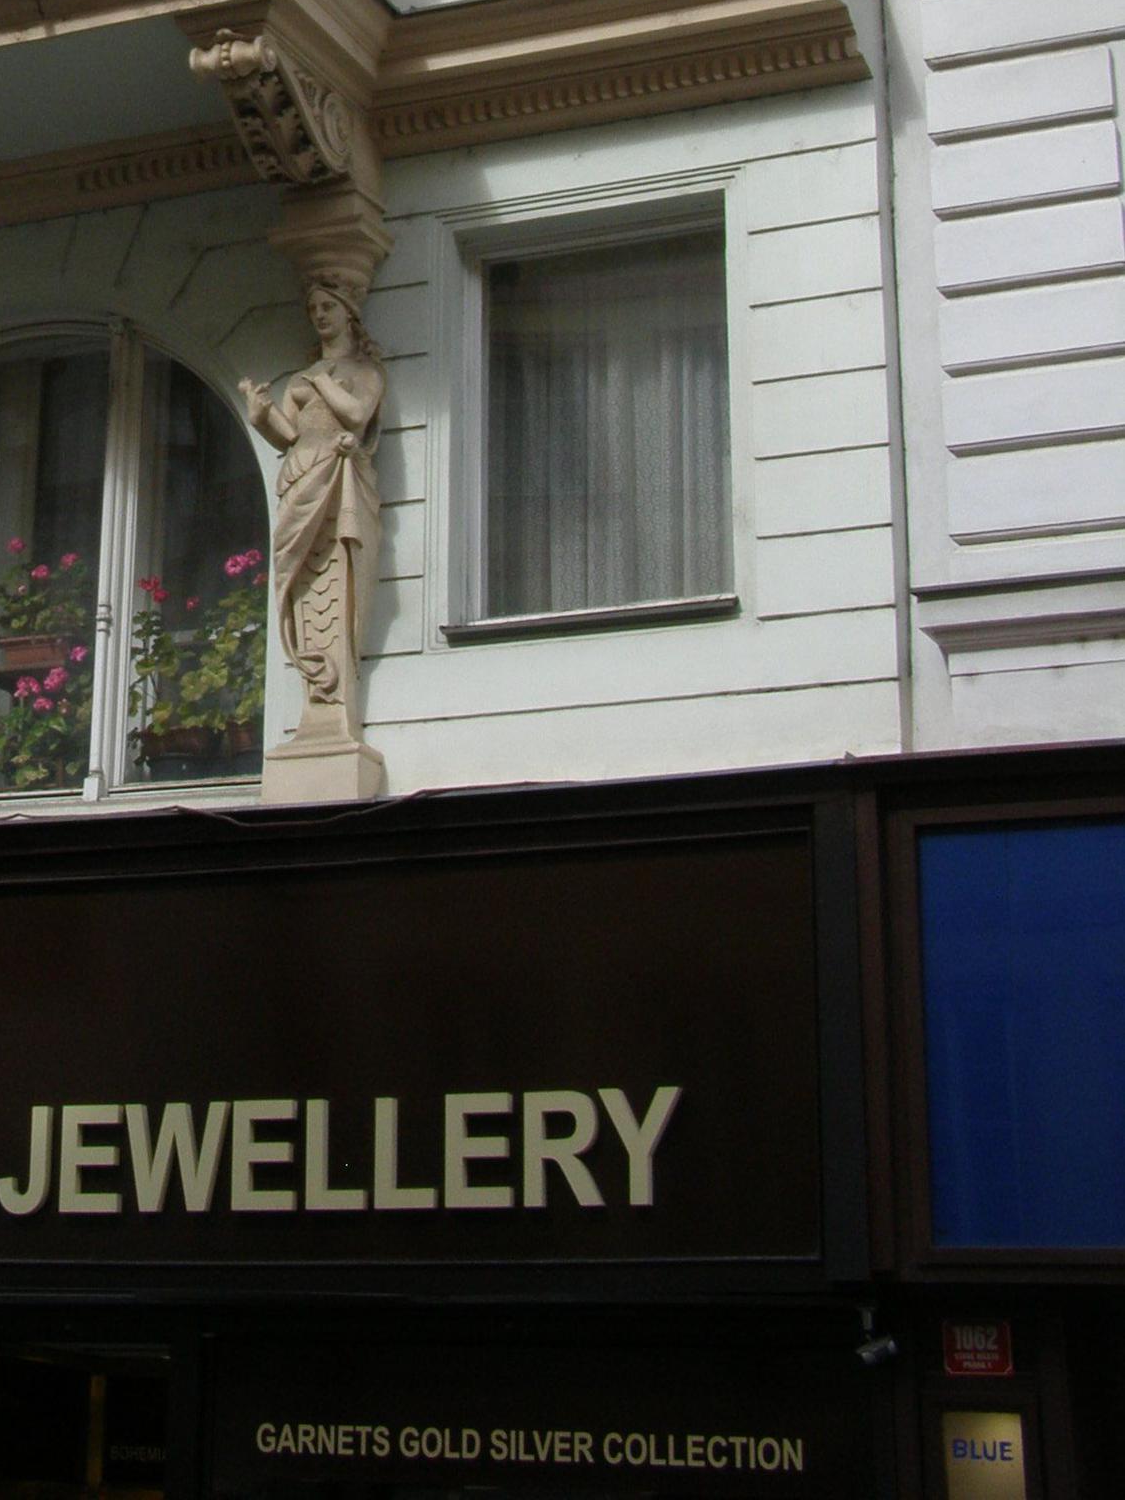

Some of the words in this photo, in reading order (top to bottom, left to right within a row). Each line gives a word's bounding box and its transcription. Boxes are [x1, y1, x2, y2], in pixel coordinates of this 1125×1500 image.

[952, 1325, 998, 1350] 1062
[256, 1422, 391, 1458] GARNETS
[399, 1426, 481, 1460] GOLD
[490, 1429, 594, 1464] SILVER
[603, 1432, 804, 1472] COLLECTION
[952, 1439, 1014, 1461] BLUE
